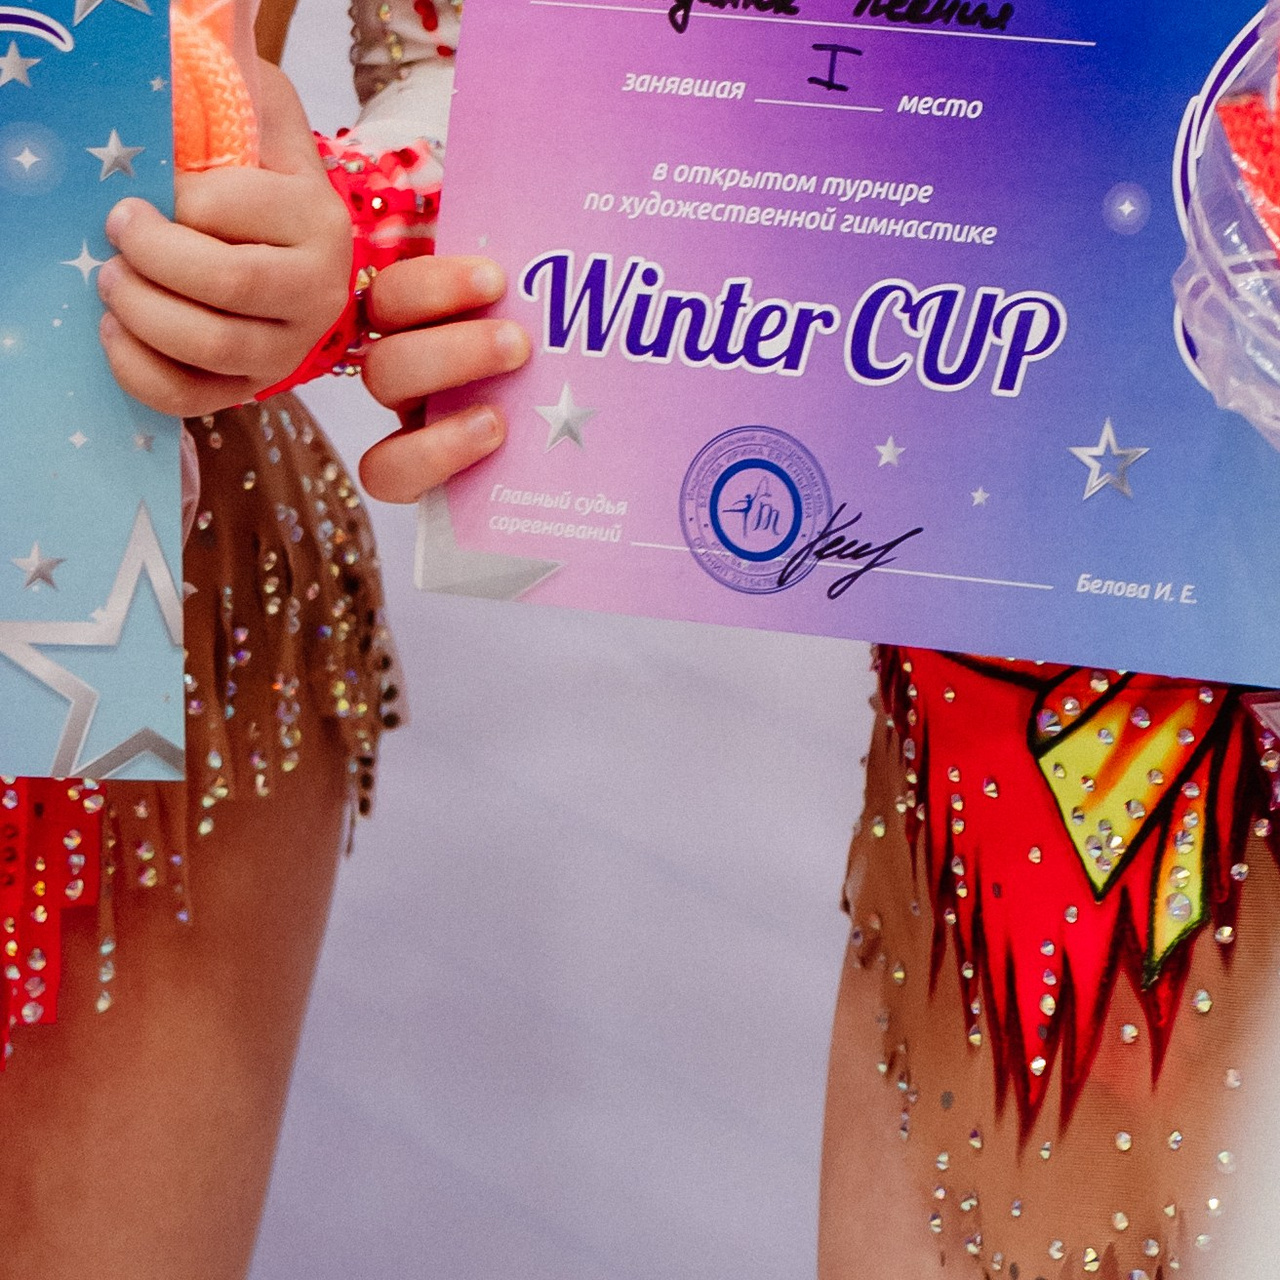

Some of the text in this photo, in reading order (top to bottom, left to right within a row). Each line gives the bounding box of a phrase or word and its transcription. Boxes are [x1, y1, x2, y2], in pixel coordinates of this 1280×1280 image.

[621, 42, 985, 120] занявшая I место
[651, 161, 935, 207] в открытом турнире
[583, 190, 999, 246] по художественной гимнастике
[517, 248, 1069, 399] Winter CUP
[489, 483, 629, 517] Главный судья
[488, 514, 623, 543] соревнований
[1075, 572, 1198, 605] Белова И. Е.
